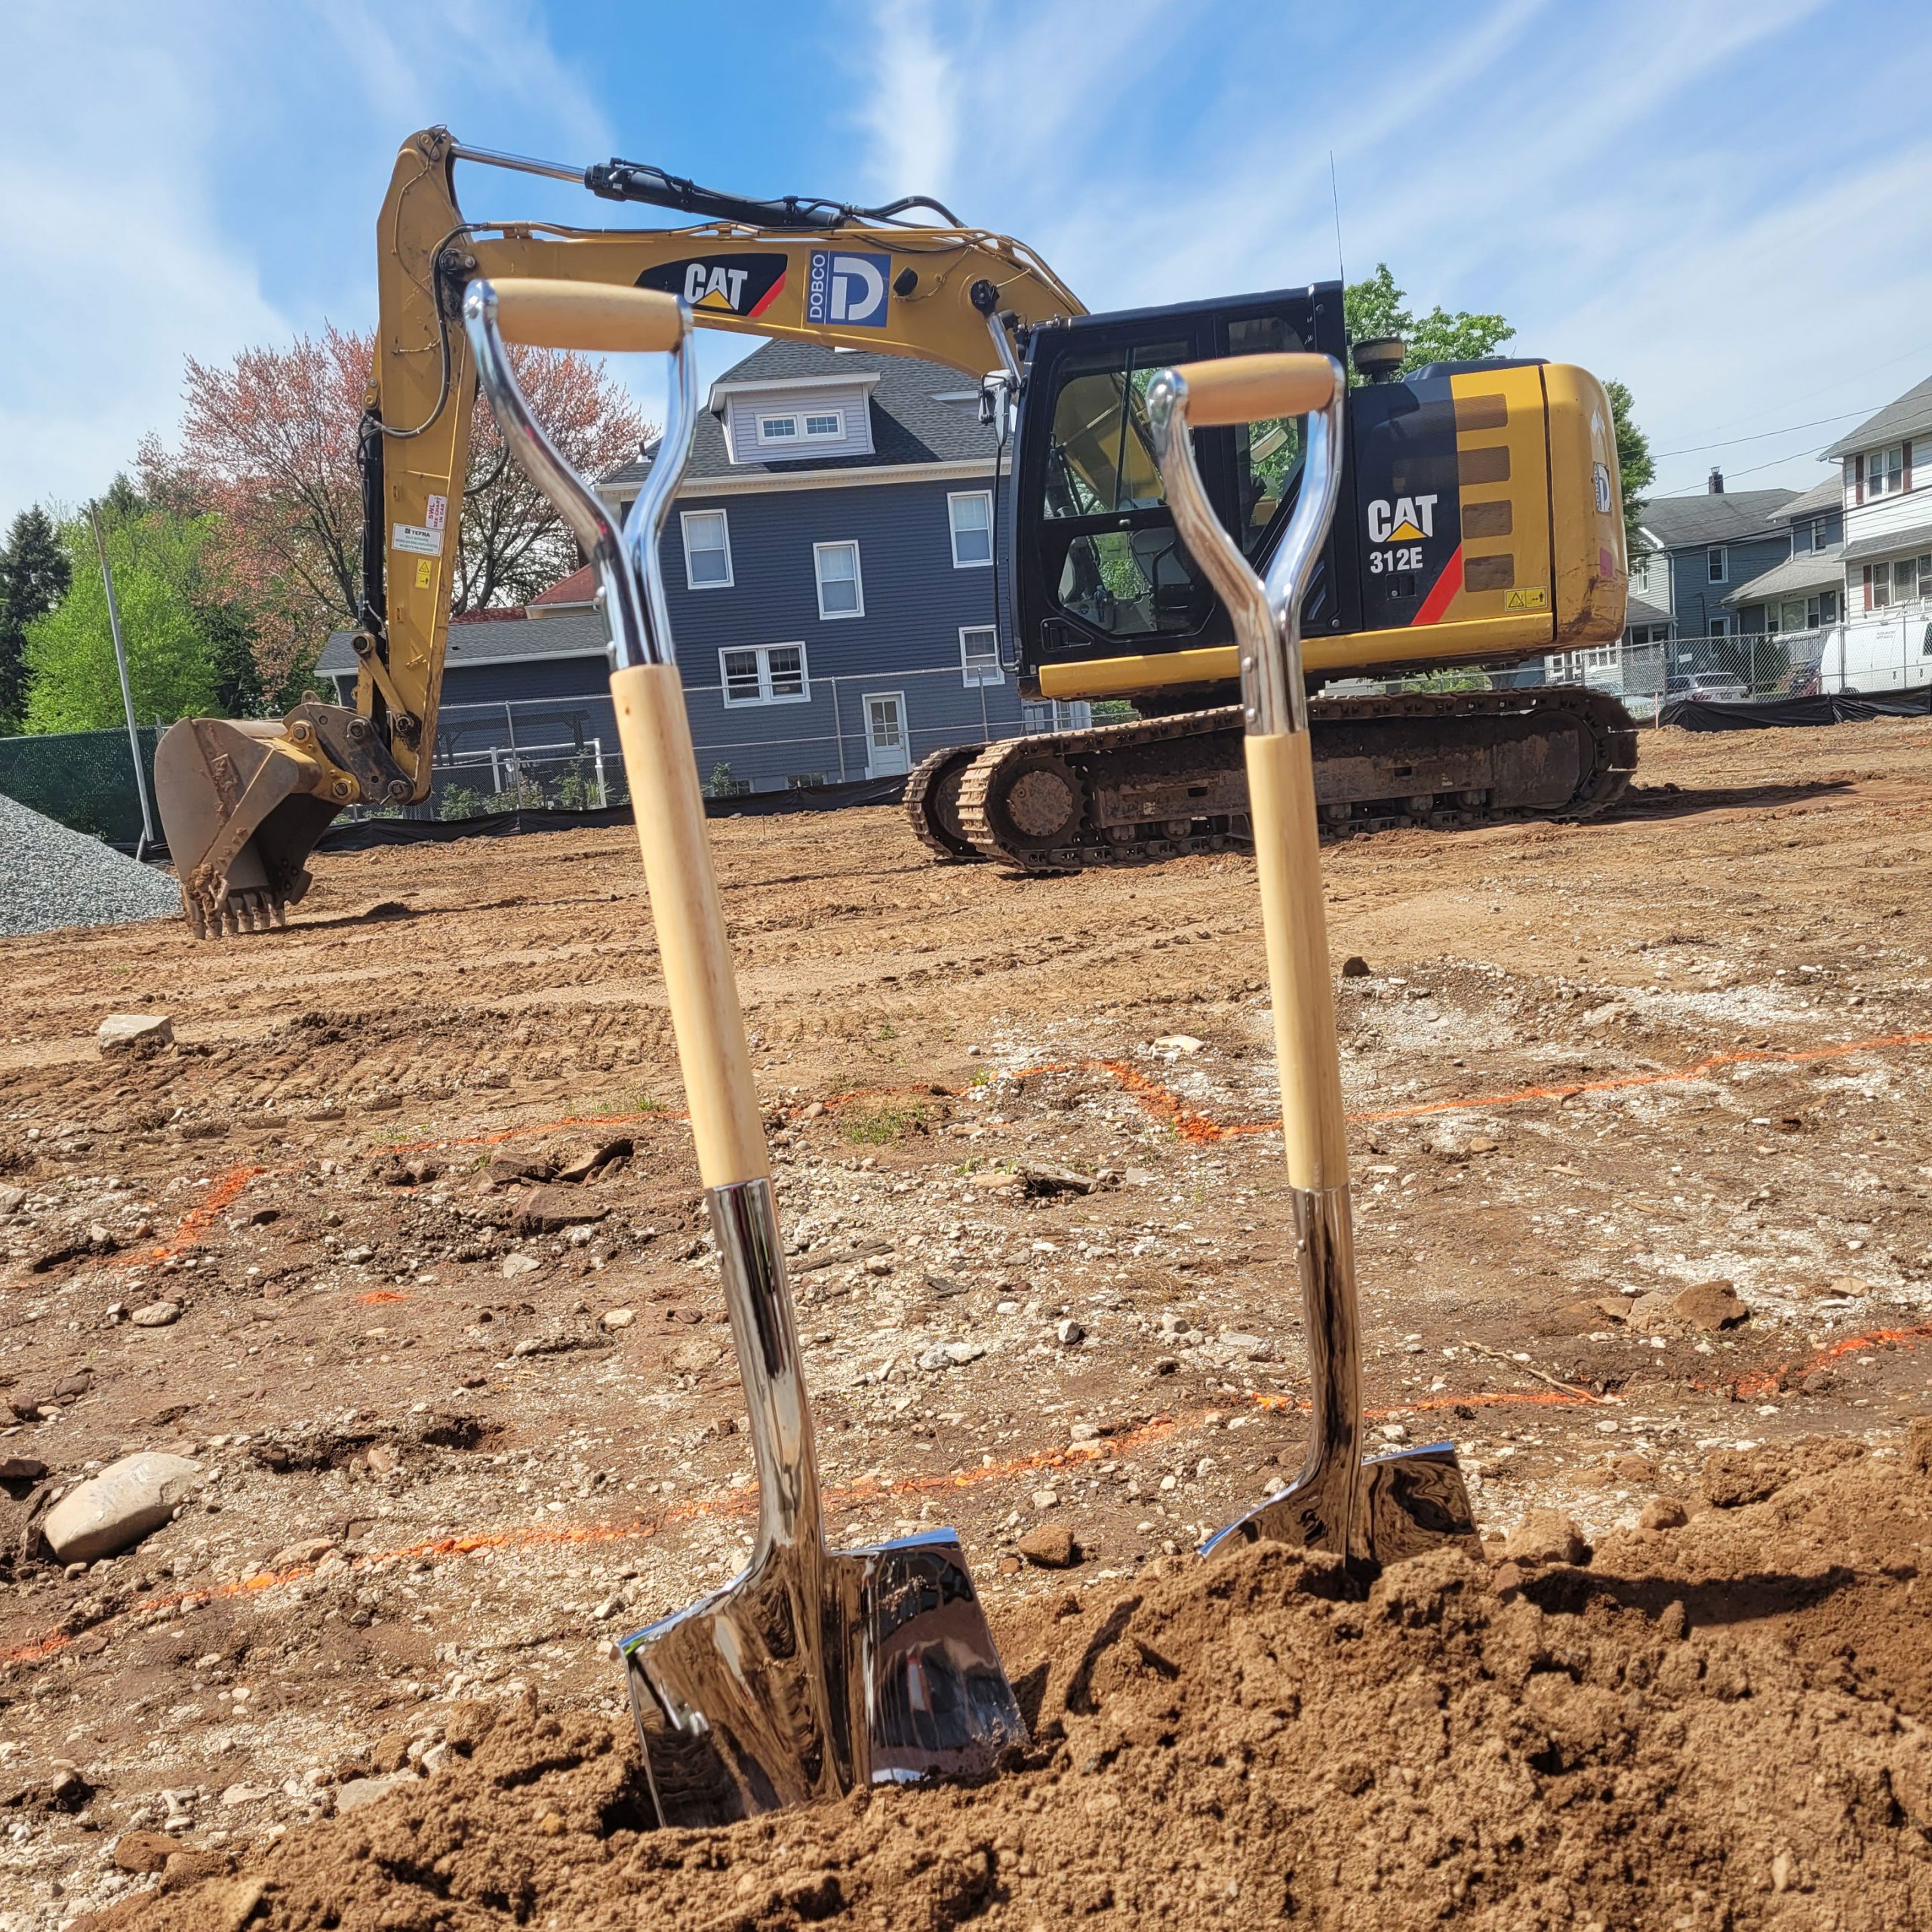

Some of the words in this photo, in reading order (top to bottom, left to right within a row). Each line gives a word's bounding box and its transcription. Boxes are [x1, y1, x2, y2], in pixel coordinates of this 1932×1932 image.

[684, 263, 748, 310] CAT
[810, 254, 826, 318] DOBCO
[830, 257, 884, 321] D
[1368, 494, 1438, 543] CAT
[1370, 546, 1423, 574] 312E
